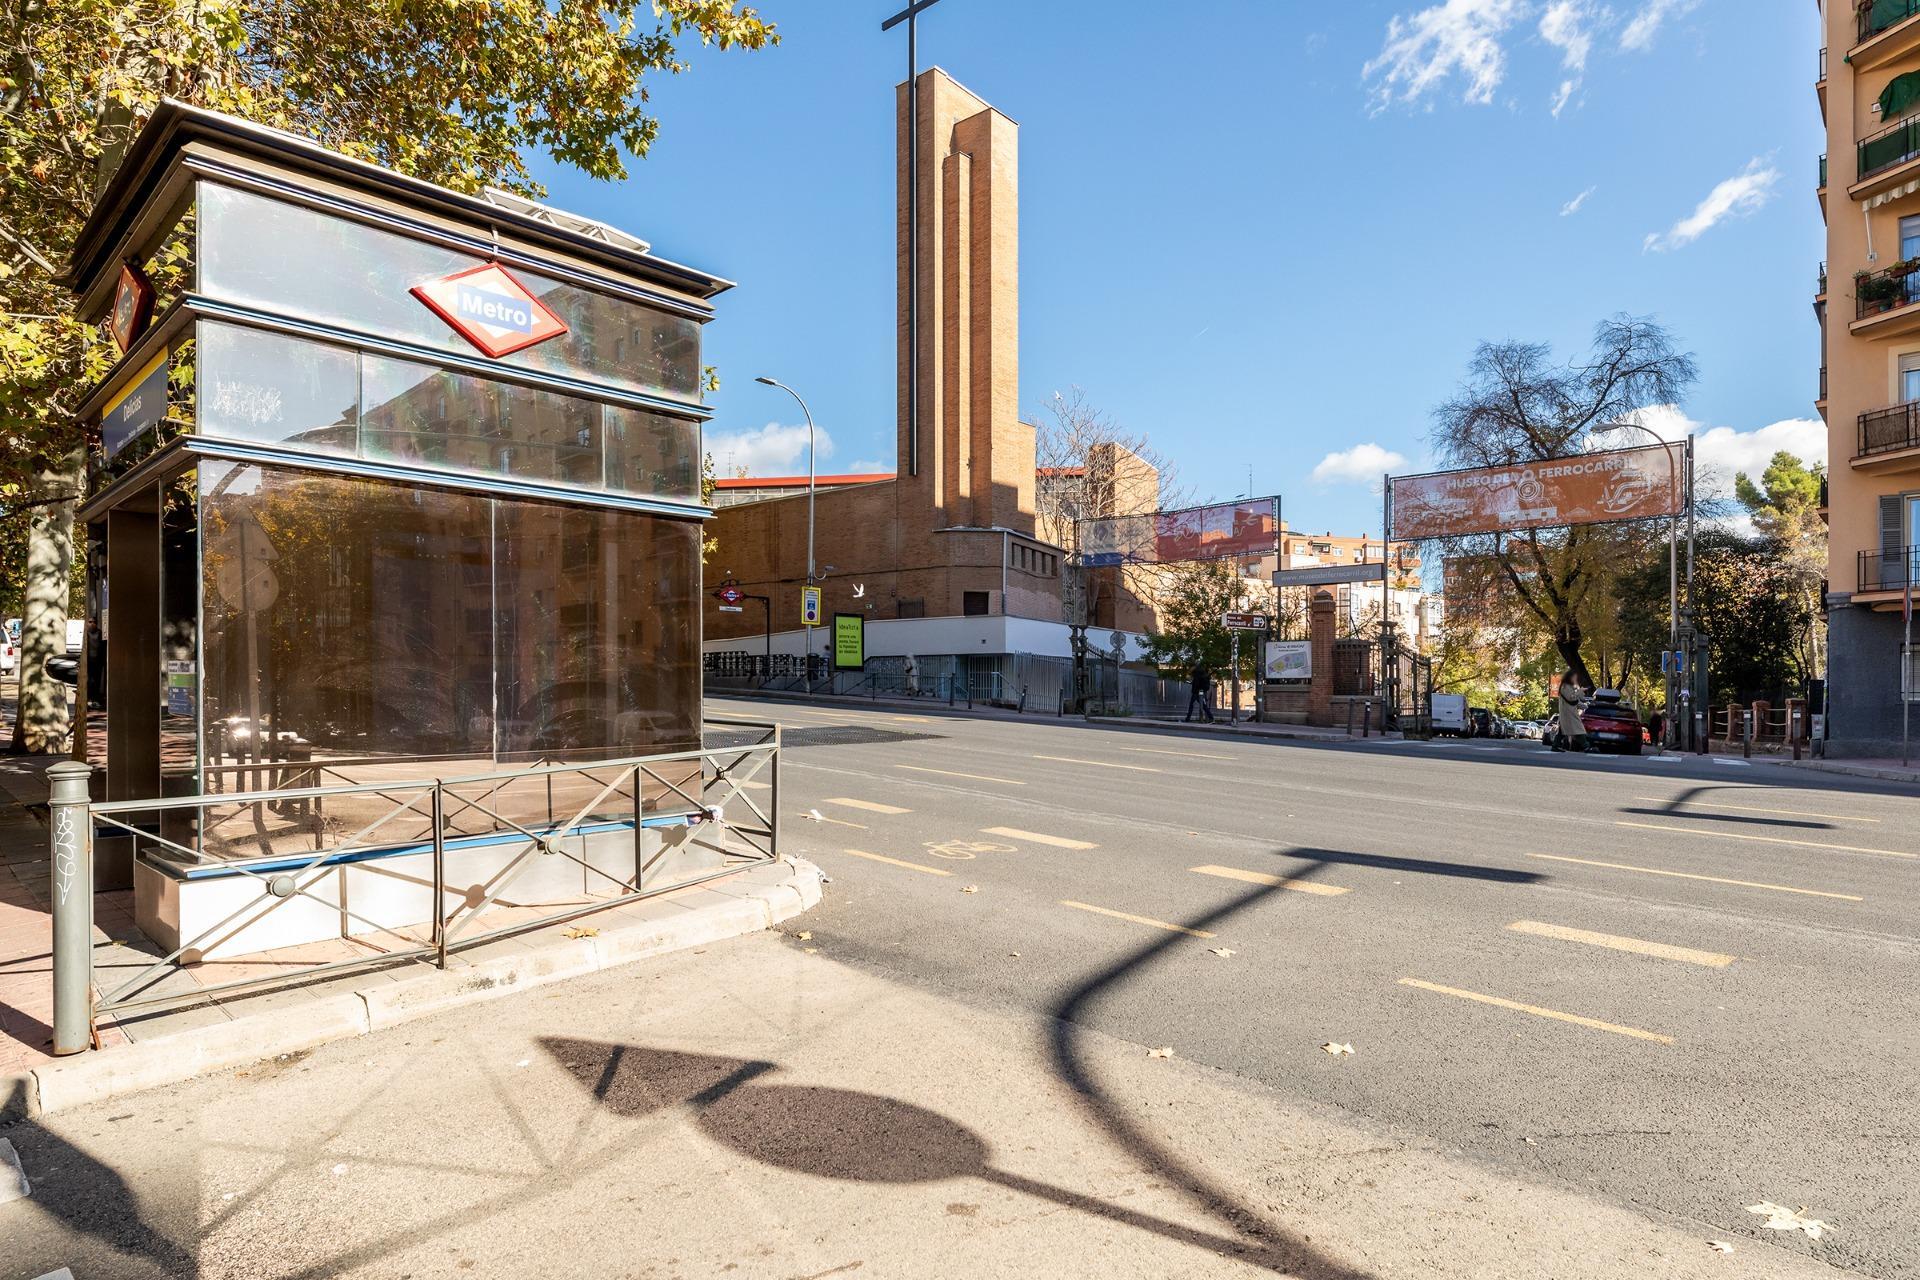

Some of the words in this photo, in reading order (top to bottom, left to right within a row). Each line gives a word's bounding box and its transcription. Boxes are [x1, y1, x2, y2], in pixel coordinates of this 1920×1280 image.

[462, 293, 527, 326] Metro
[1446, 475, 1491, 489] MUSEO
[1538, 457, 1636, 479] FERROCARRIL
